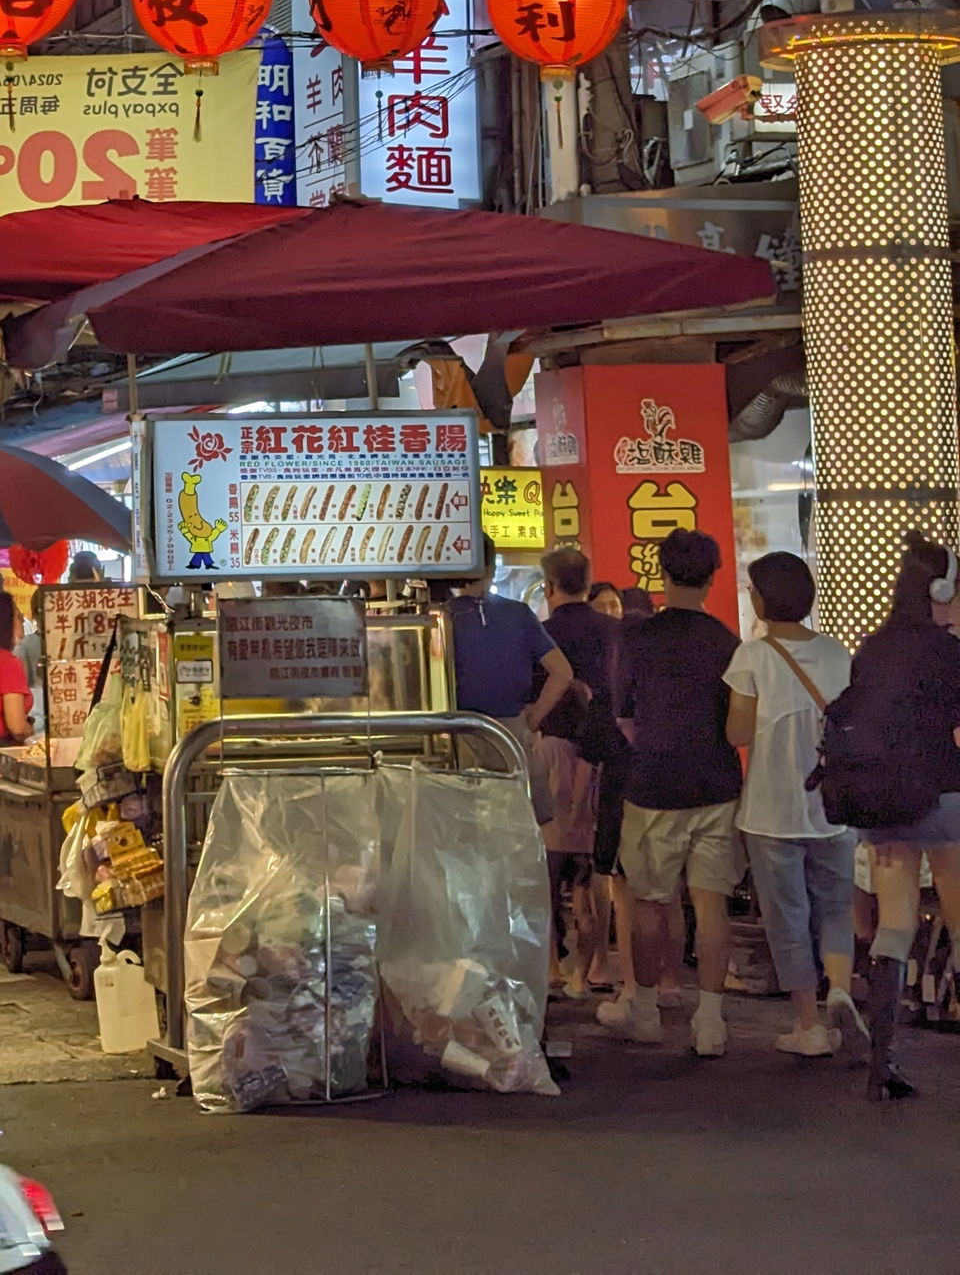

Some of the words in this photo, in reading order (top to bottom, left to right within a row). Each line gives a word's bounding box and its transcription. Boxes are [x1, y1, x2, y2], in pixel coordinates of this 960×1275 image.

[255, 424, 468, 454] 紅花紅桂香腸
[46, 588, 135, 612] 澎湖花生
